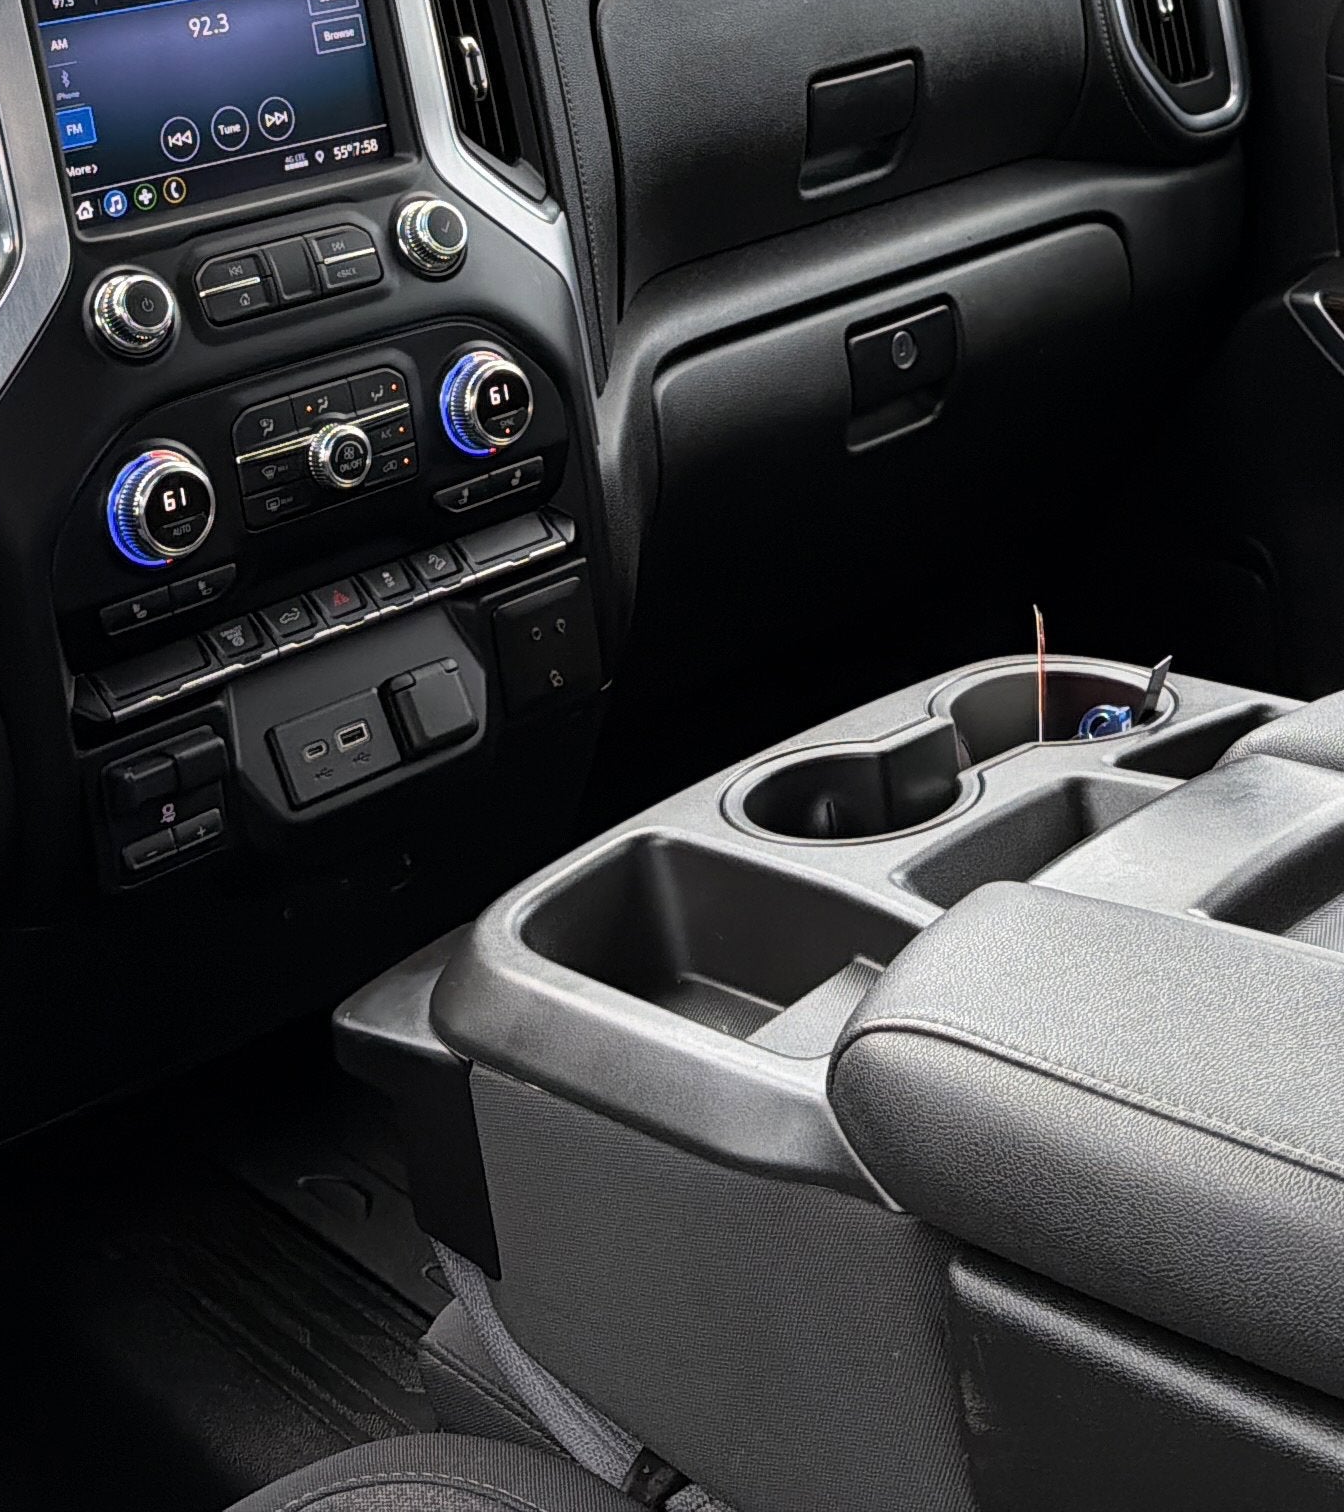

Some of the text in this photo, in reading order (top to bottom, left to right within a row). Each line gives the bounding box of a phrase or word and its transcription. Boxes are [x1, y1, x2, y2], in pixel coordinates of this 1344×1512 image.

[188, 12, 230, 38] 92.3
[323, 26, 355, 42] Browse
[51, 38, 68, 51] AM
[65, 122, 83, 136] FM
[218, 122, 242, 135] Tune
[352, 138, 379, 156] 7:58
[65, 164, 91, 178] More
[488, 383, 509, 406] 61
[339, 459, 363, 475] ON/OFF
[162, 487, 187, 513] 61
[172, 524, 192, 537] AUTO
